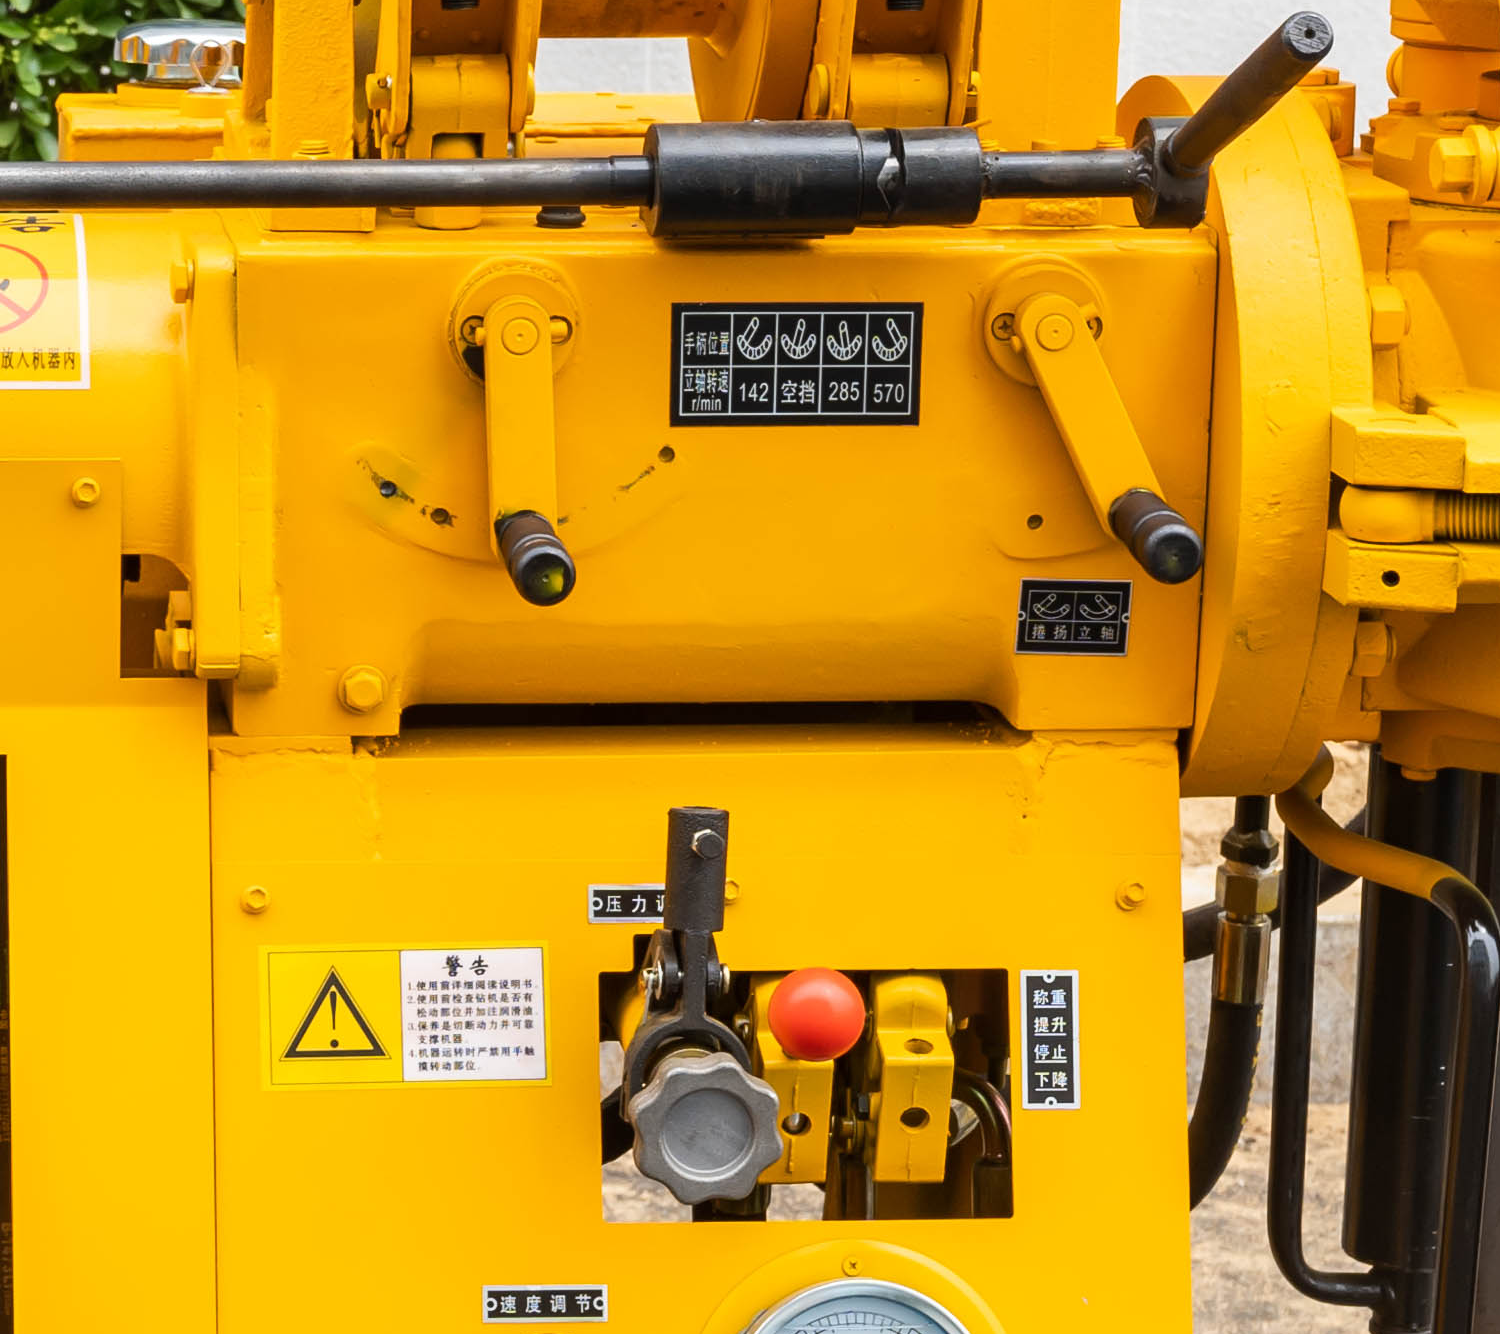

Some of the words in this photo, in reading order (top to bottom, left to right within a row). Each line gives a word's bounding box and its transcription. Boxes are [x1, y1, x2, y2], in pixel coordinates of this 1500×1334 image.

[684, 331, 730, 356] 手柄位置
[683, 370, 729, 394] 立轴转速
[739, 383, 769, 402] 142
[781, 380, 816, 404] 空挡
[828, 382, 860, 402] 285
[873, 384, 905, 404] 570
[691, 396, 722, 412] r/min
[1077, 626, 1114, 640] 立轴
[442, 955, 489, 977] 警告
[1033, 989, 1066, 1006] 称重
[1034, 1017, 1066, 1033] 提升
[1034, 1044, 1067, 1060] 停止
[1034, 1071, 1068, 1088] 下降
[500, 1295, 592, 1313] 速度调节
